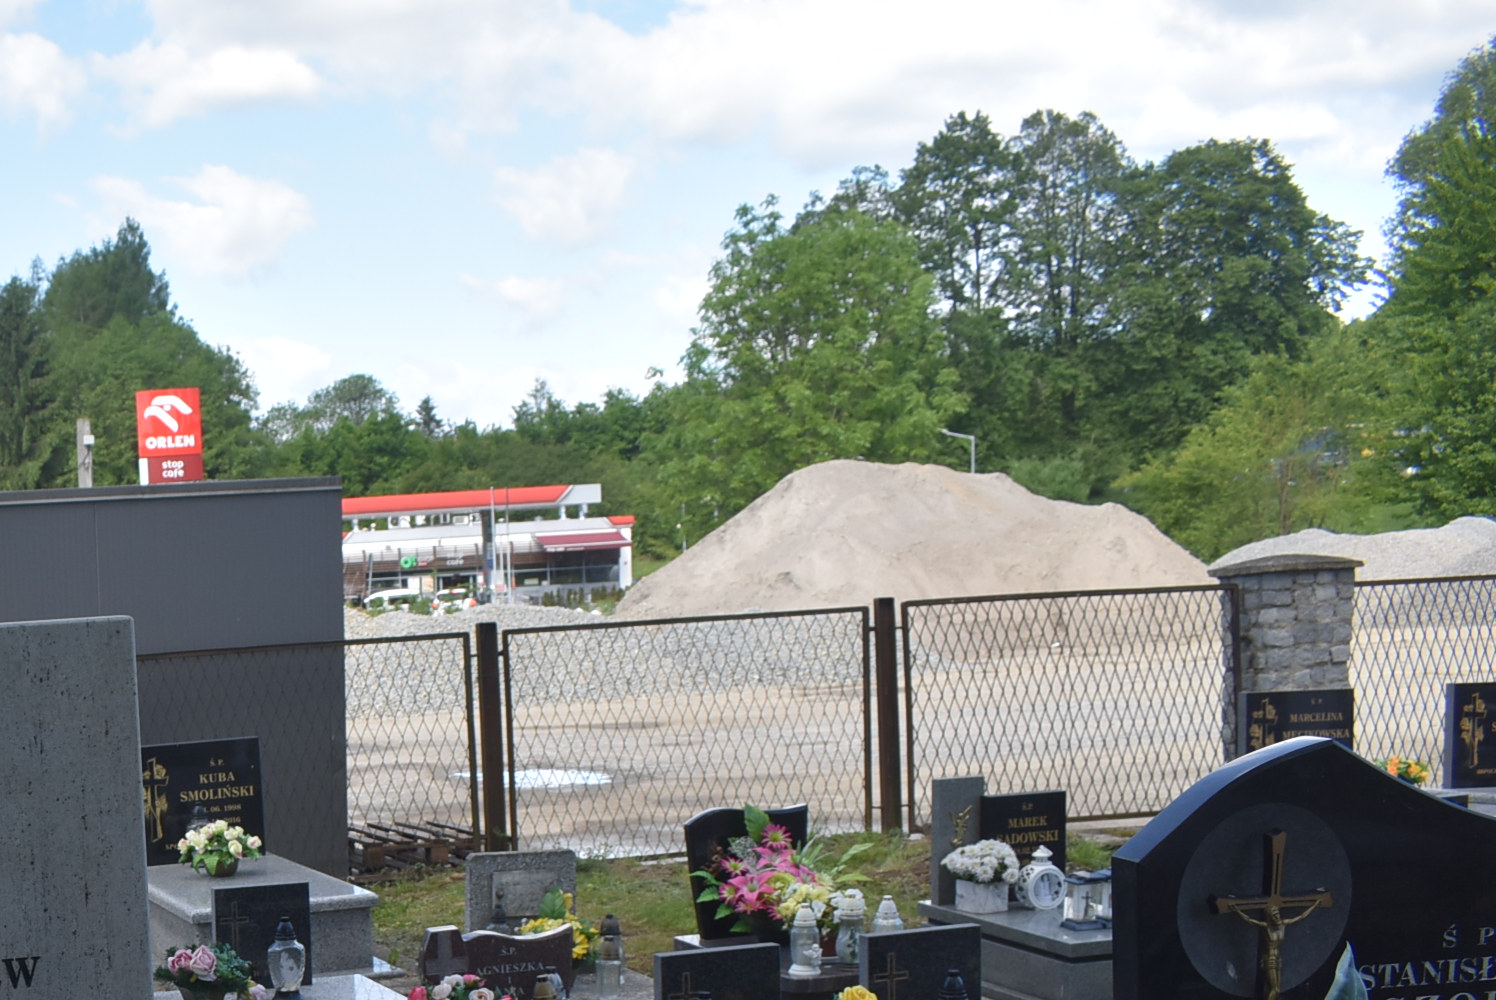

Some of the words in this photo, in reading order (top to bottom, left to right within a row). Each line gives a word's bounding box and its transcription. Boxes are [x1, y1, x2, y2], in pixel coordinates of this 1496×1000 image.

[145, 434, 196, 450] ORLEN
[162, 459, 185, 469] stop
[162, 468, 185, 478] cafe
[1289, 711, 1344, 723] MARCELINA
[199, 771, 236, 784] KUBA
[179, 784, 255, 803] SMOLIŃSKI
[1007, 815, 1049, 829] MAREK
[476, 960, 546, 977] AGNIESZKA
